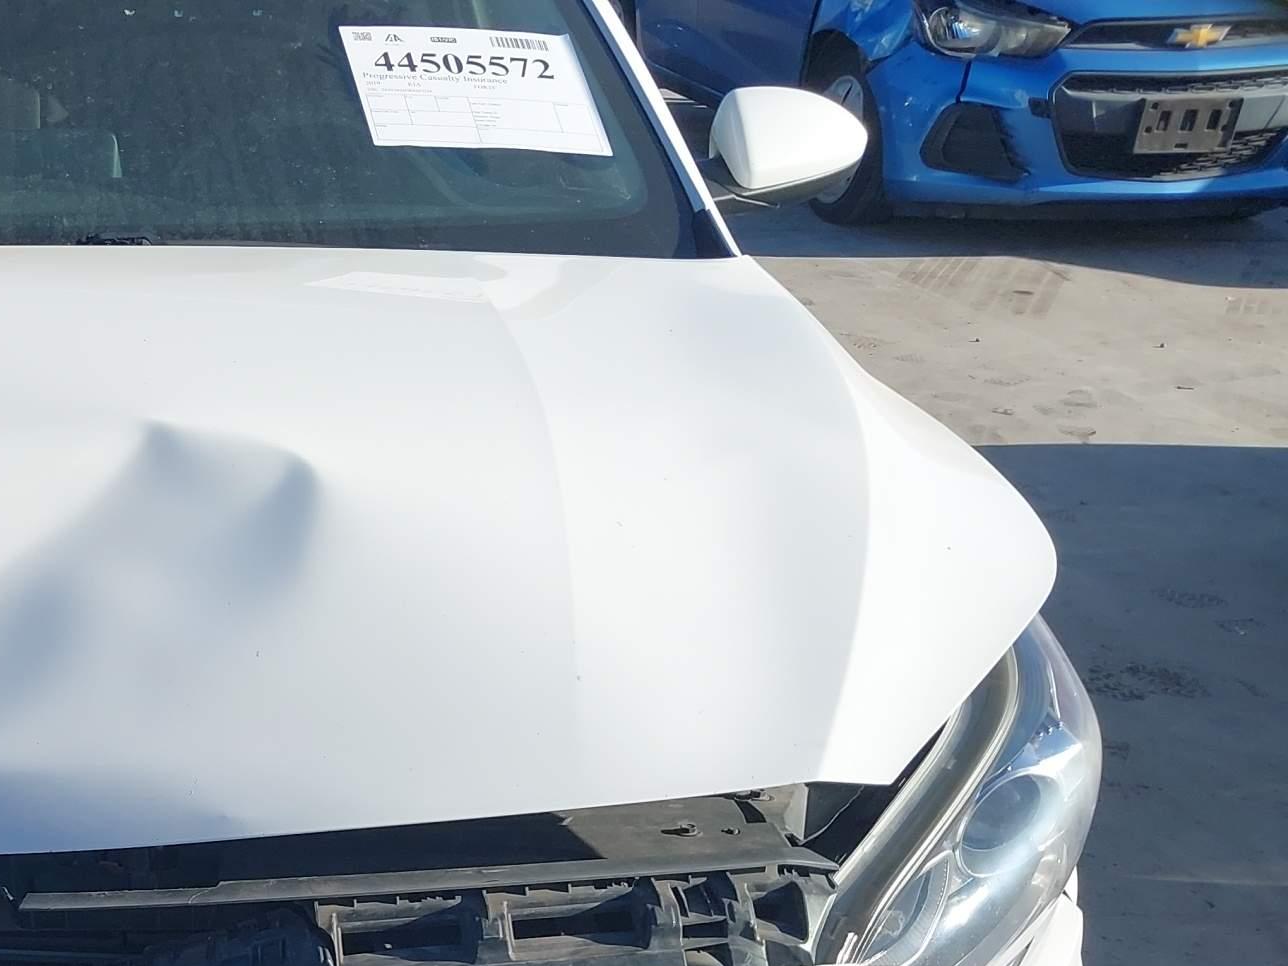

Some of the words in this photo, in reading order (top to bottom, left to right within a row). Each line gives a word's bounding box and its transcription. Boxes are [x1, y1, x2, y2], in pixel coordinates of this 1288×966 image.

[374, 51, 555, 80] 44505572
[363, 72, 417, 81] Progressive
[419, 74, 460, 83] Casualty
[463, 76, 508, 84] Insurance
